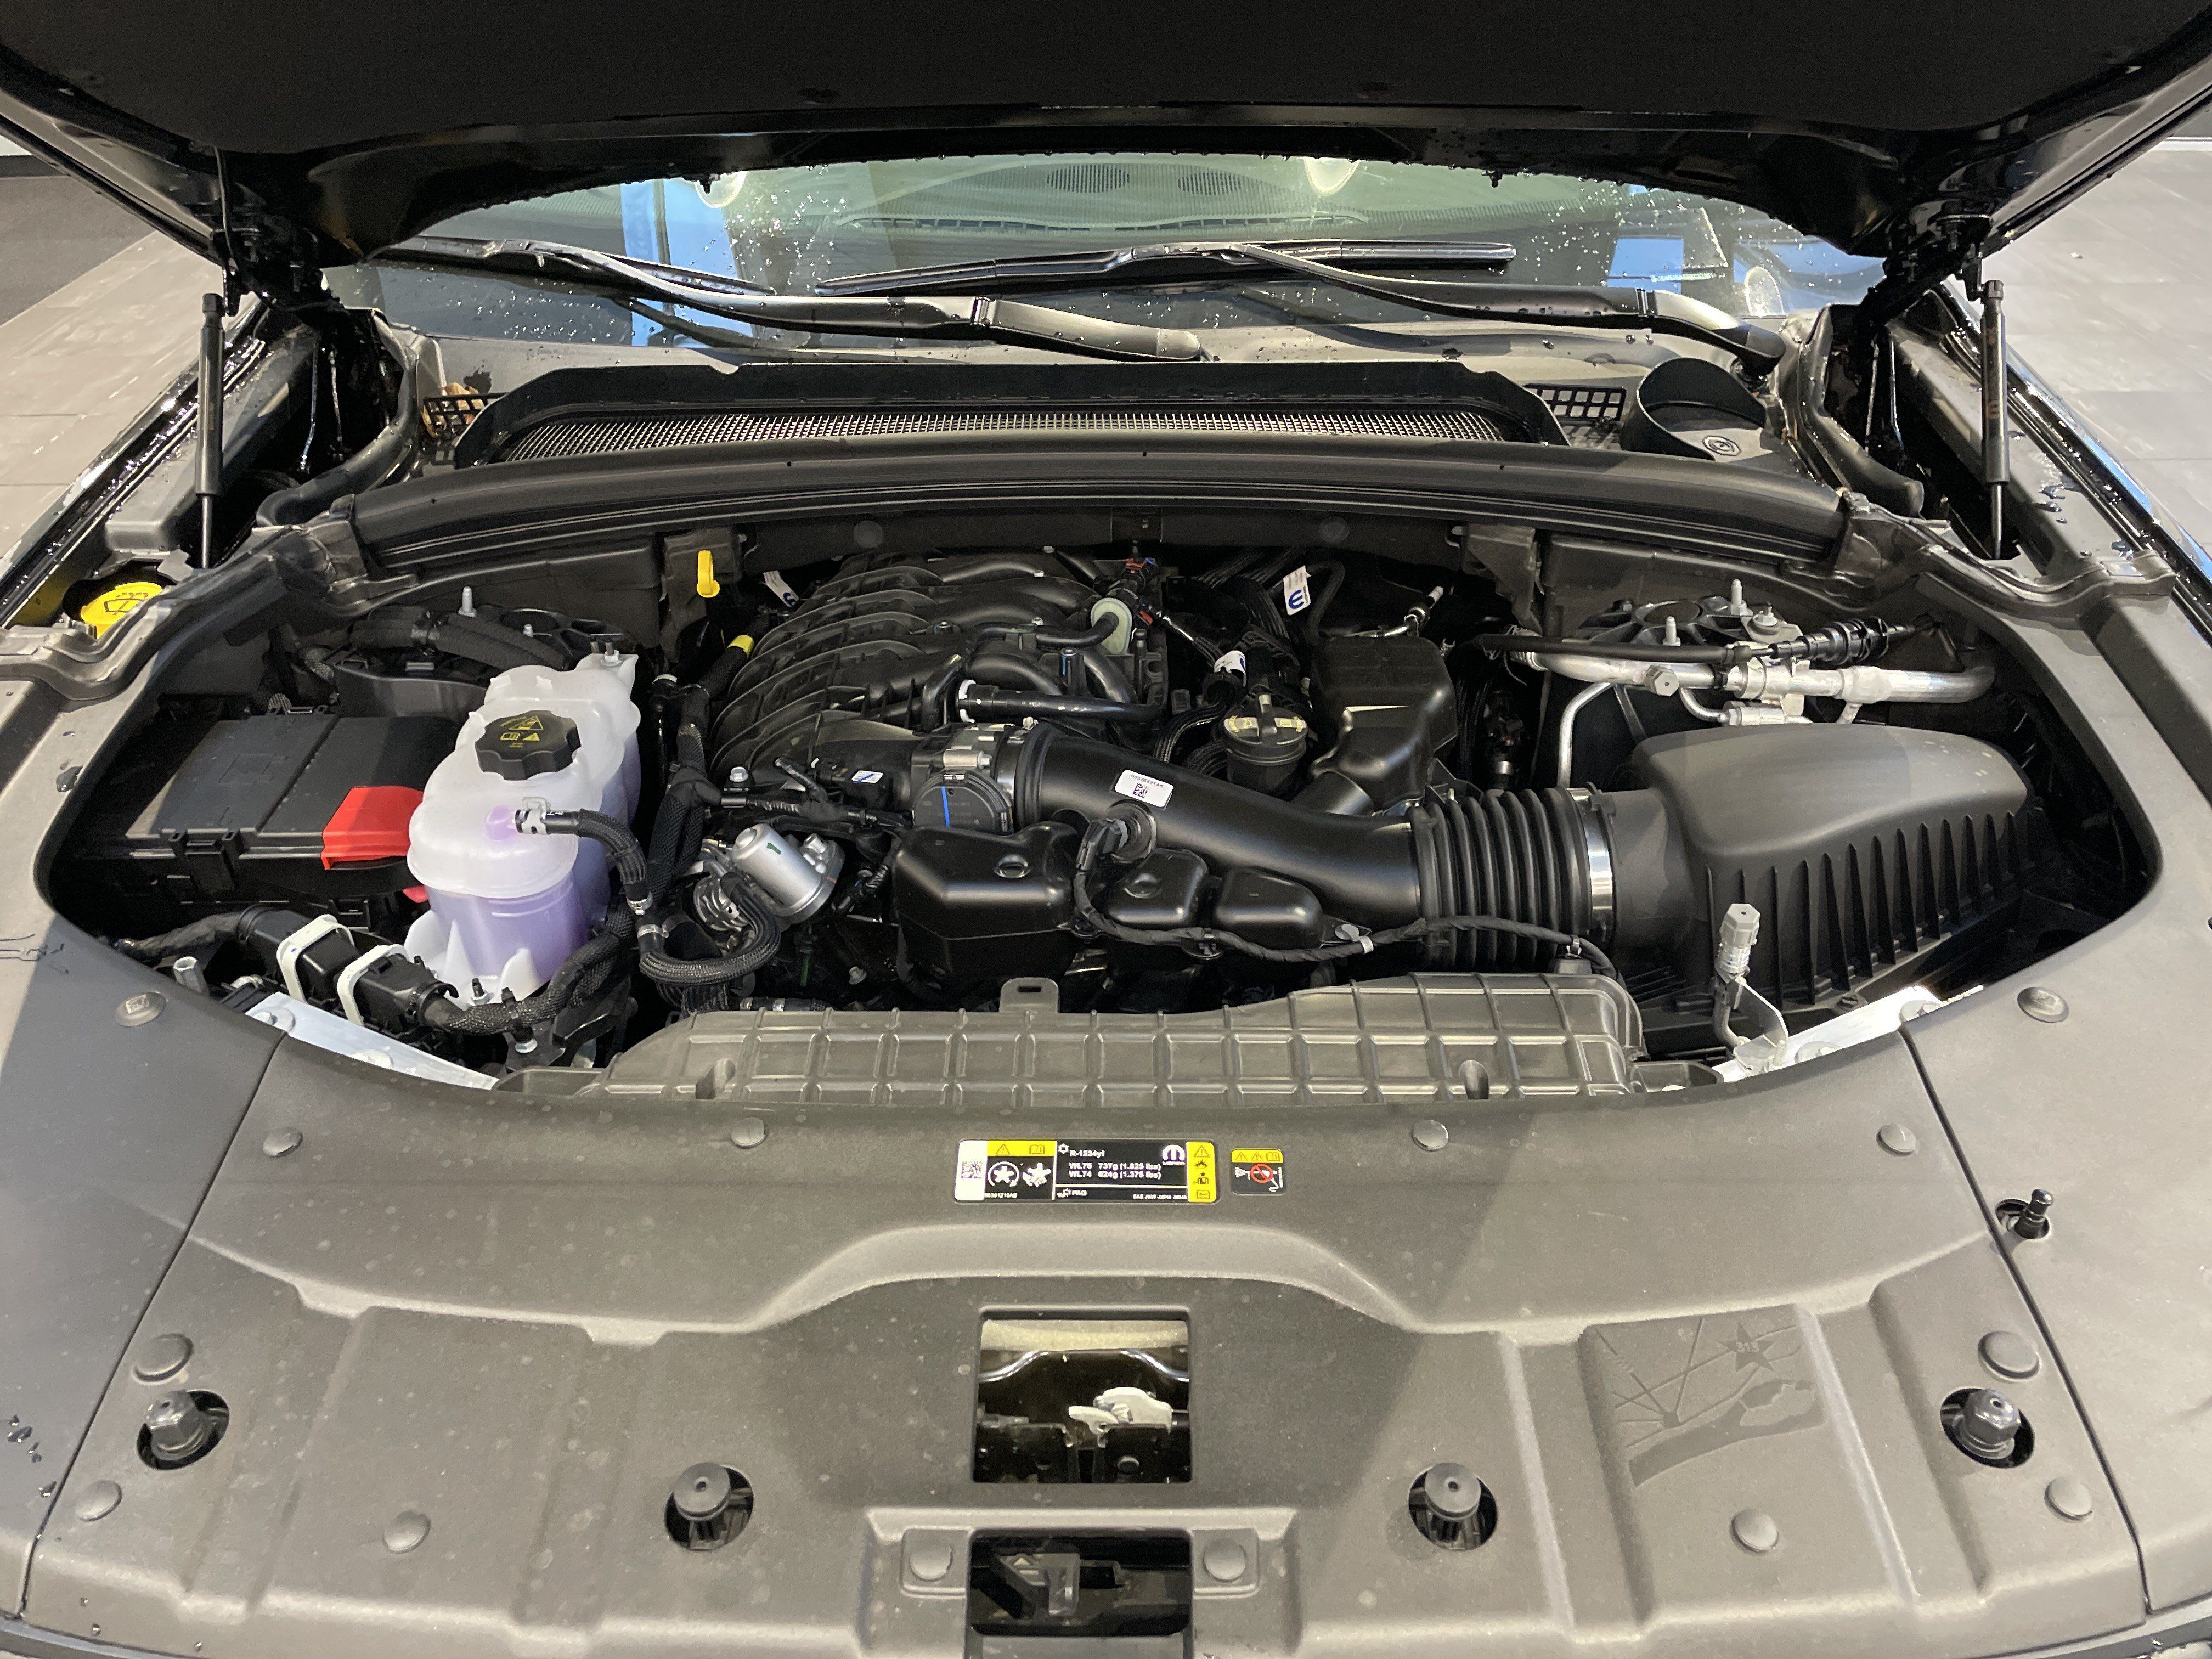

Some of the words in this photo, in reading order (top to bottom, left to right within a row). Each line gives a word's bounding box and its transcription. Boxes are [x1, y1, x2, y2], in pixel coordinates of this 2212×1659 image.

[1069, 1149, 1105, 1159] R-1234yf
[1098, 1162, 1118, 1171] 737g
[1146, 1163, 1161, 1171] lbs)
[1098, 1170, 1118, 1180] 624g
[1146, 1171, 1161, 1180] lbs)
